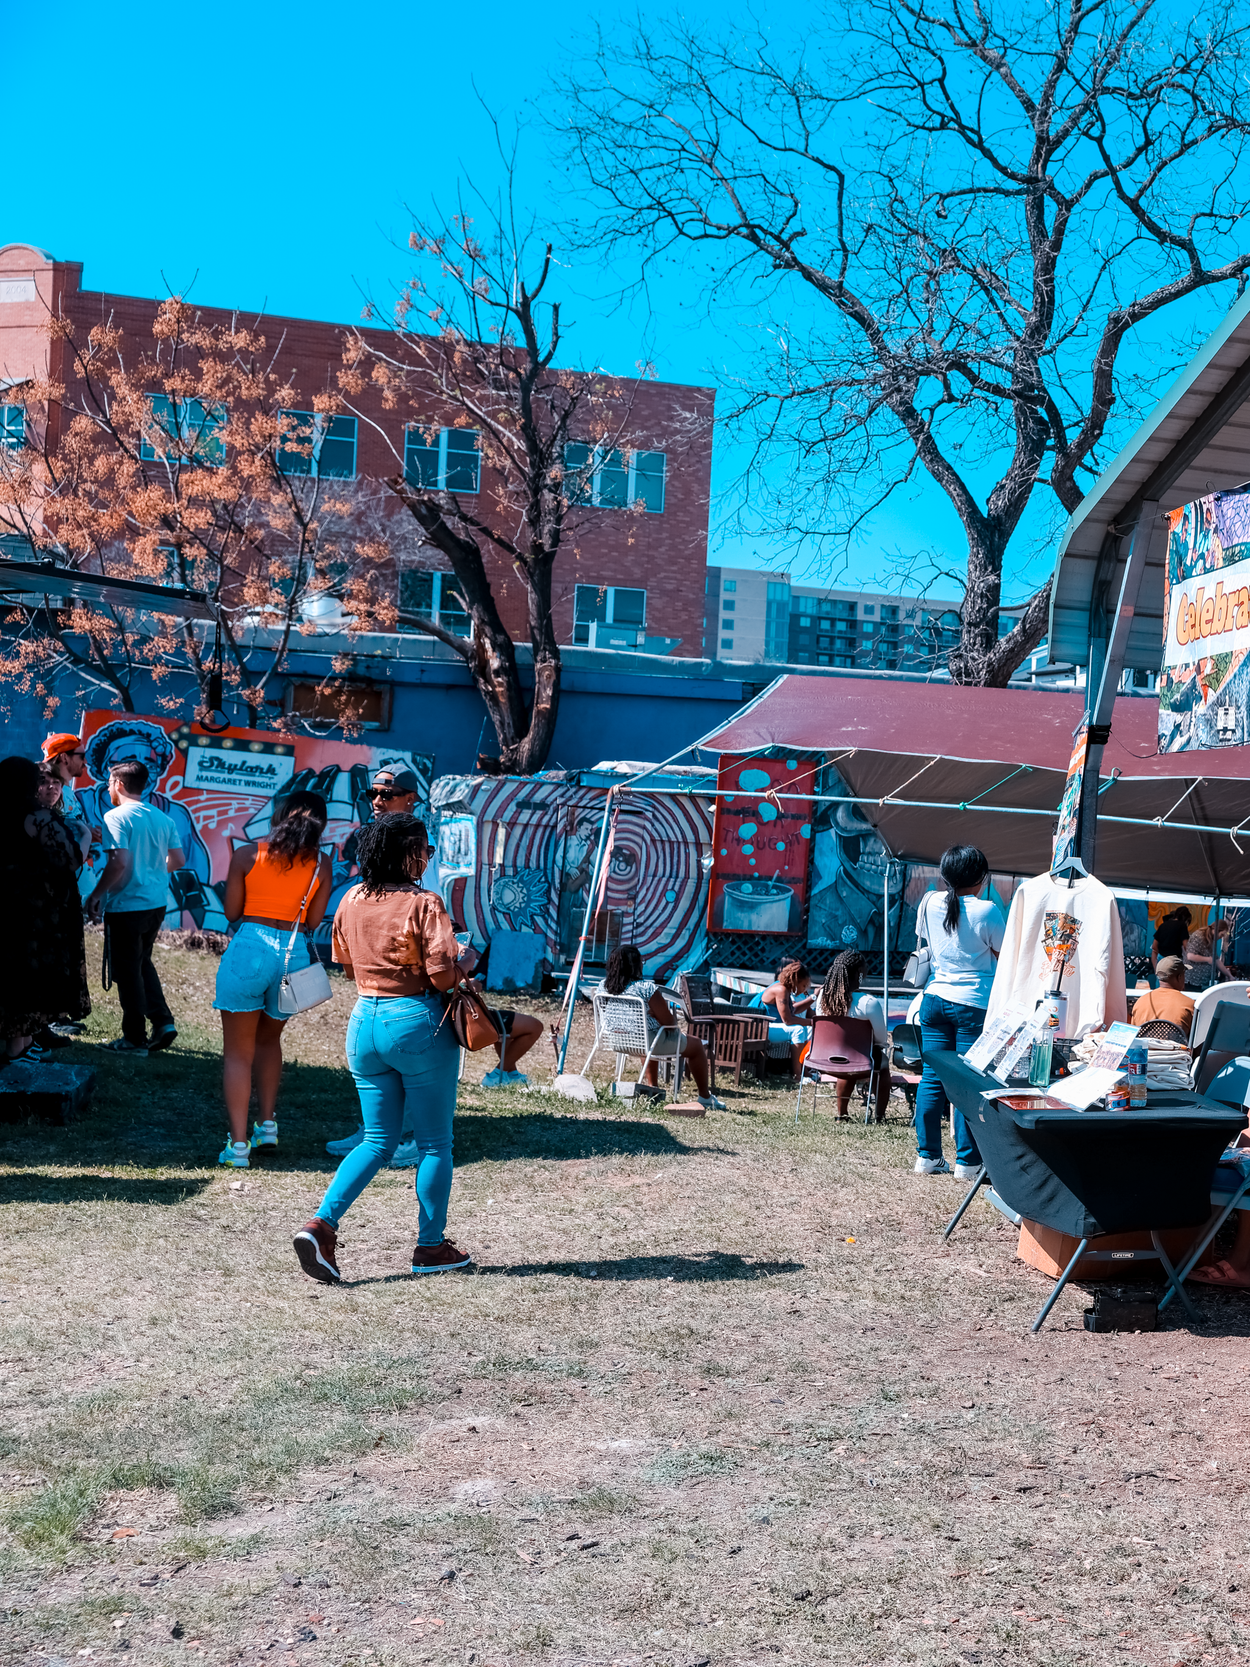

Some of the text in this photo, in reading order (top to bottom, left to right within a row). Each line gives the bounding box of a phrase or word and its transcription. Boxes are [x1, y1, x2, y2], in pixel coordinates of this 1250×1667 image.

[197, 756, 278, 776] Skylark
[195, 774, 278, 790] MARGARET WRIGHT
